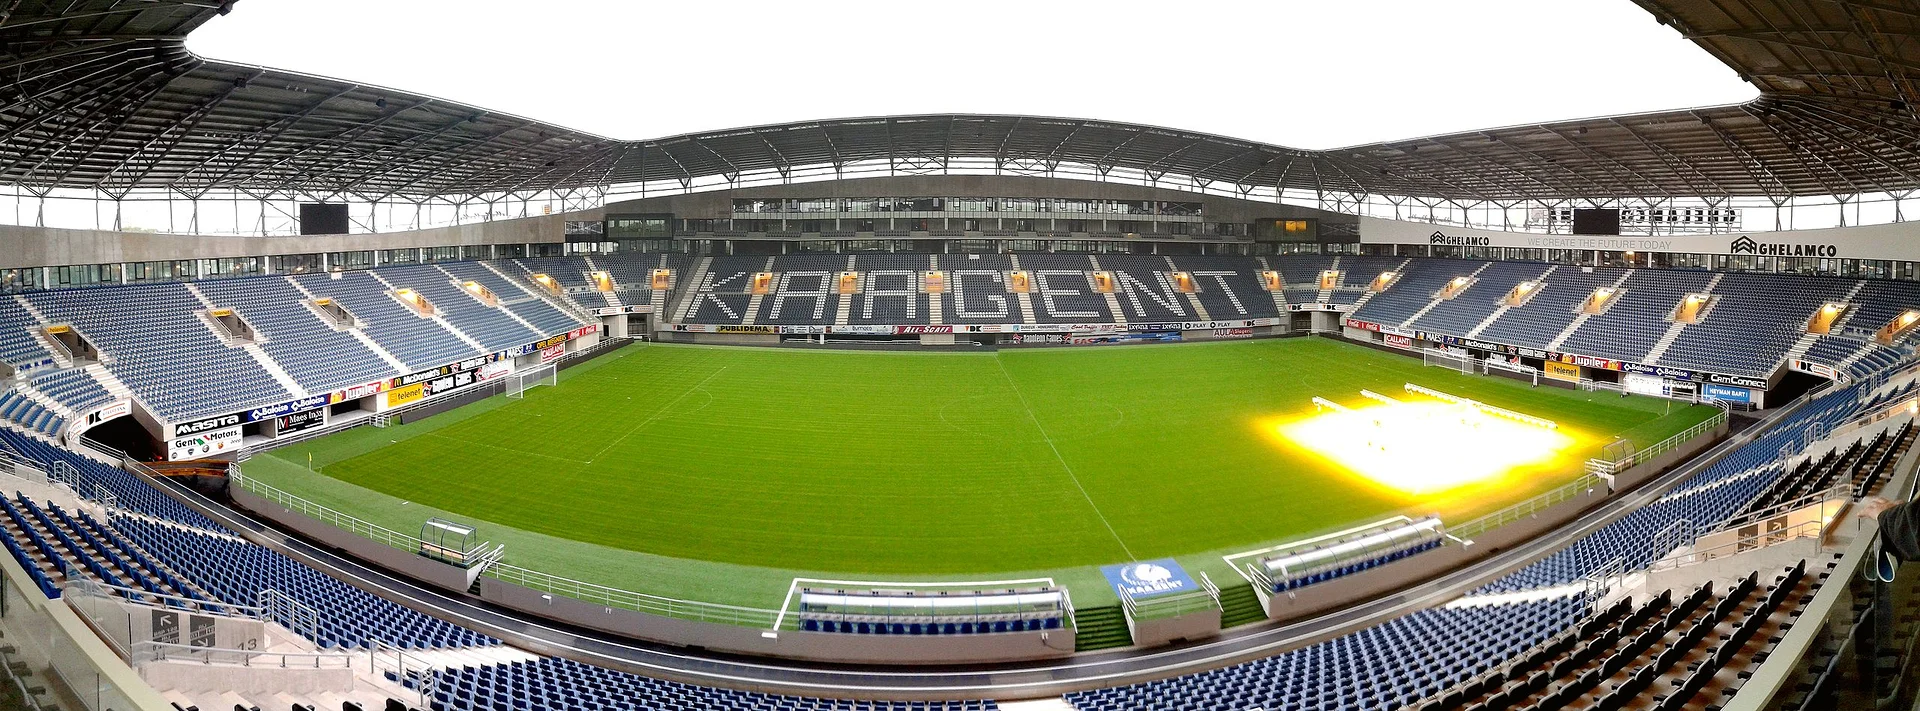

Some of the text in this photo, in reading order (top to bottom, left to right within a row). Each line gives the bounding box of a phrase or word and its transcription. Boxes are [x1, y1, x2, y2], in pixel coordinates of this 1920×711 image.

[1446, 236, 1490, 246] GHELAMCO
[1527, 237, 1672, 250] WE CREATE THE FUTURE TODAY
[1759, 243, 1837, 257] GHELAMCO
[1386, 334, 1410, 346] CALLANT
[1464, 340, 1497, 351] McDonald's
[1573, 354, 1607, 369] Jupiler
[1631, 363, 1654, 373] Baloise
[402, 369, 440, 385] McDonald's
[1553, 365, 1577, 377] telenet
[1664, 367, 1688, 378] Baloise
[397, 387, 421, 400] telenet
[299, 396, 325, 409] Baloise
[262, 404, 289, 417] Baloise
[289, 412, 308, 424] Maes
[175, 430, 238, 448] Gent Motors
[237, 638, 257, 651] 13
